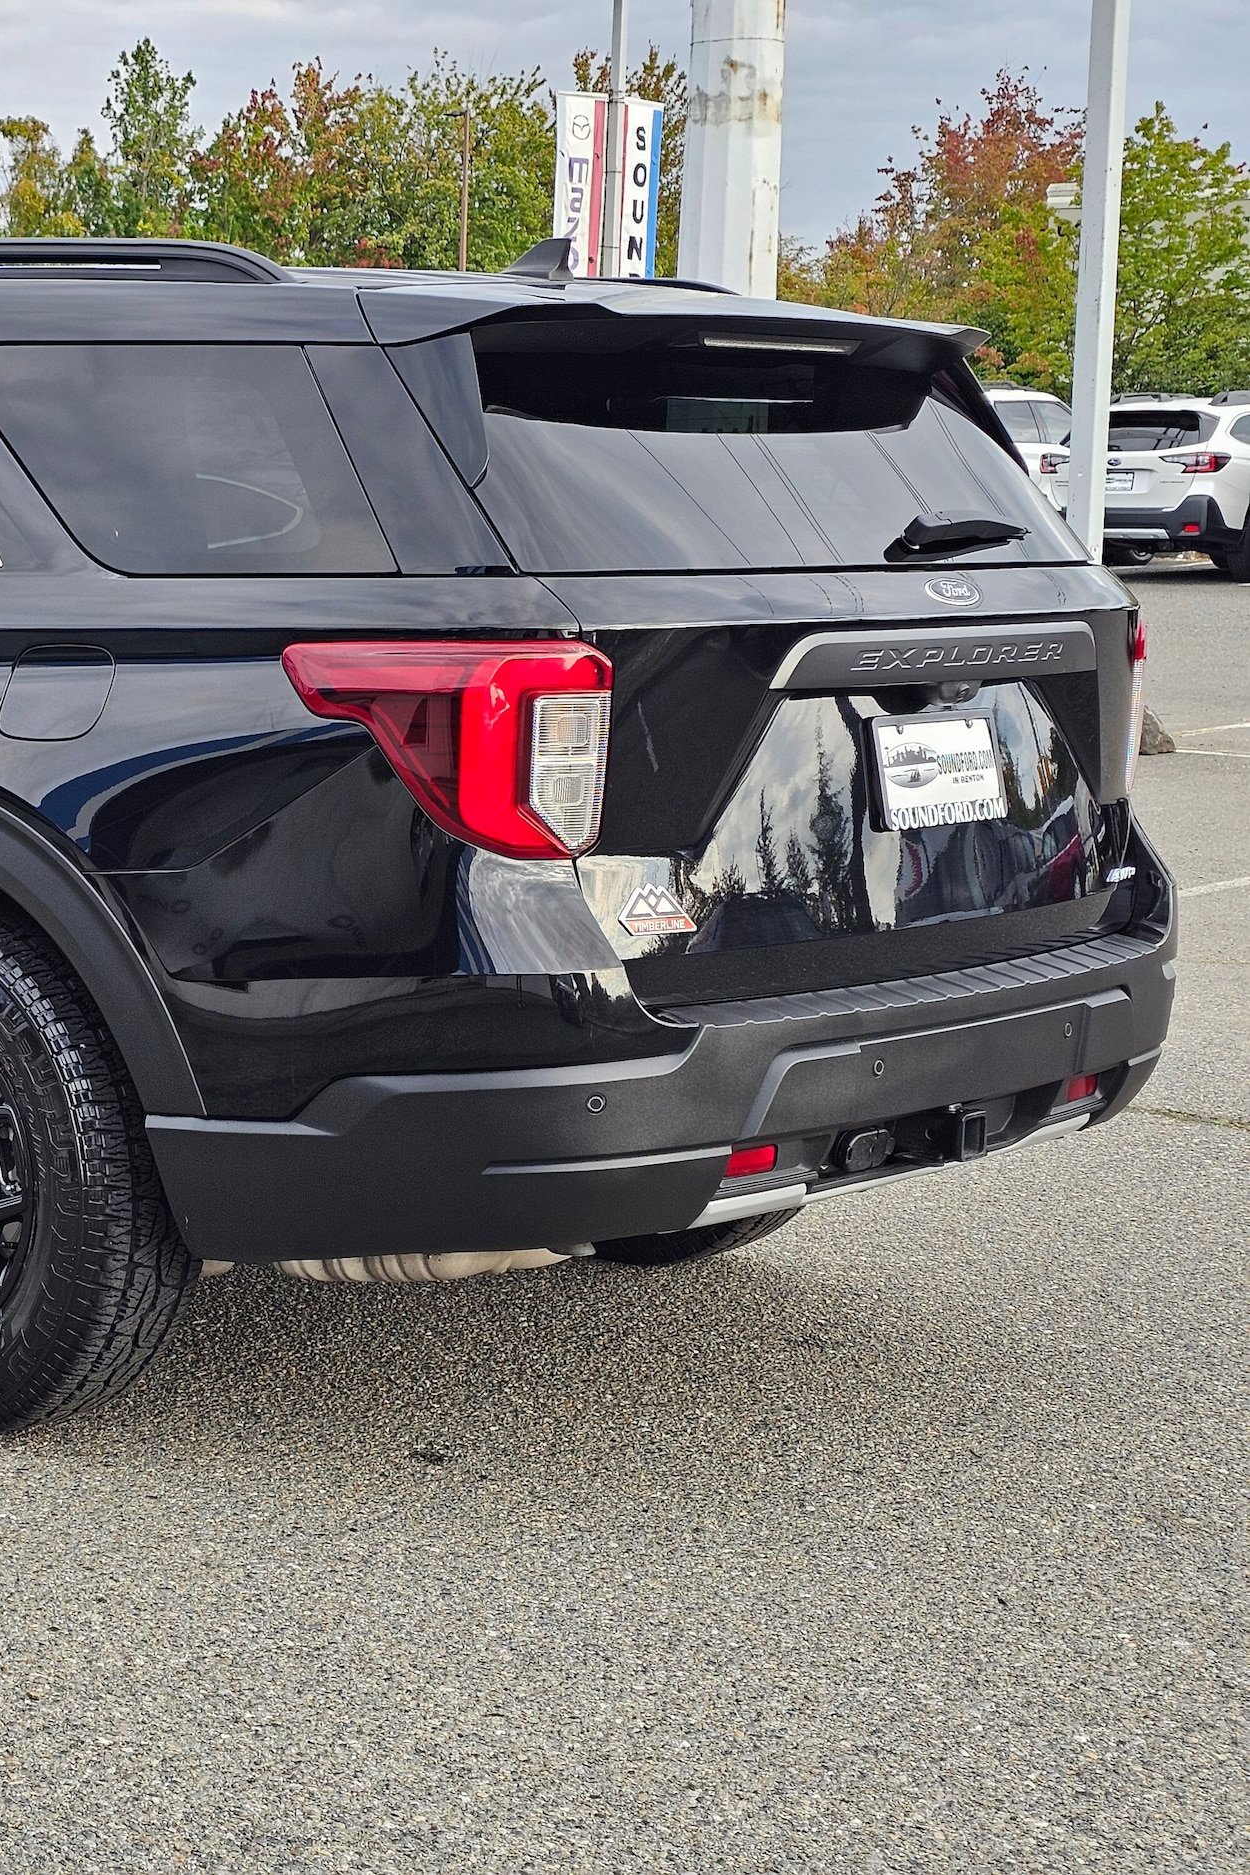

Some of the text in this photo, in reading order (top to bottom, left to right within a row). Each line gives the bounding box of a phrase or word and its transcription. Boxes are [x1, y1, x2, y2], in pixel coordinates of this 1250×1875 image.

[626, 126, 648, 278] SOUN
[940, 579, 971, 598] Ford
[849, 641, 1065, 671] EXPLORER
[936, 749, 995, 775] SOUNDFORD.COM
[952, 774, 985, 784] IN RENTON
[890, 797, 1007, 832] SOUNDFORD.COM
[633, 920, 686, 934] TIMBERLINE
